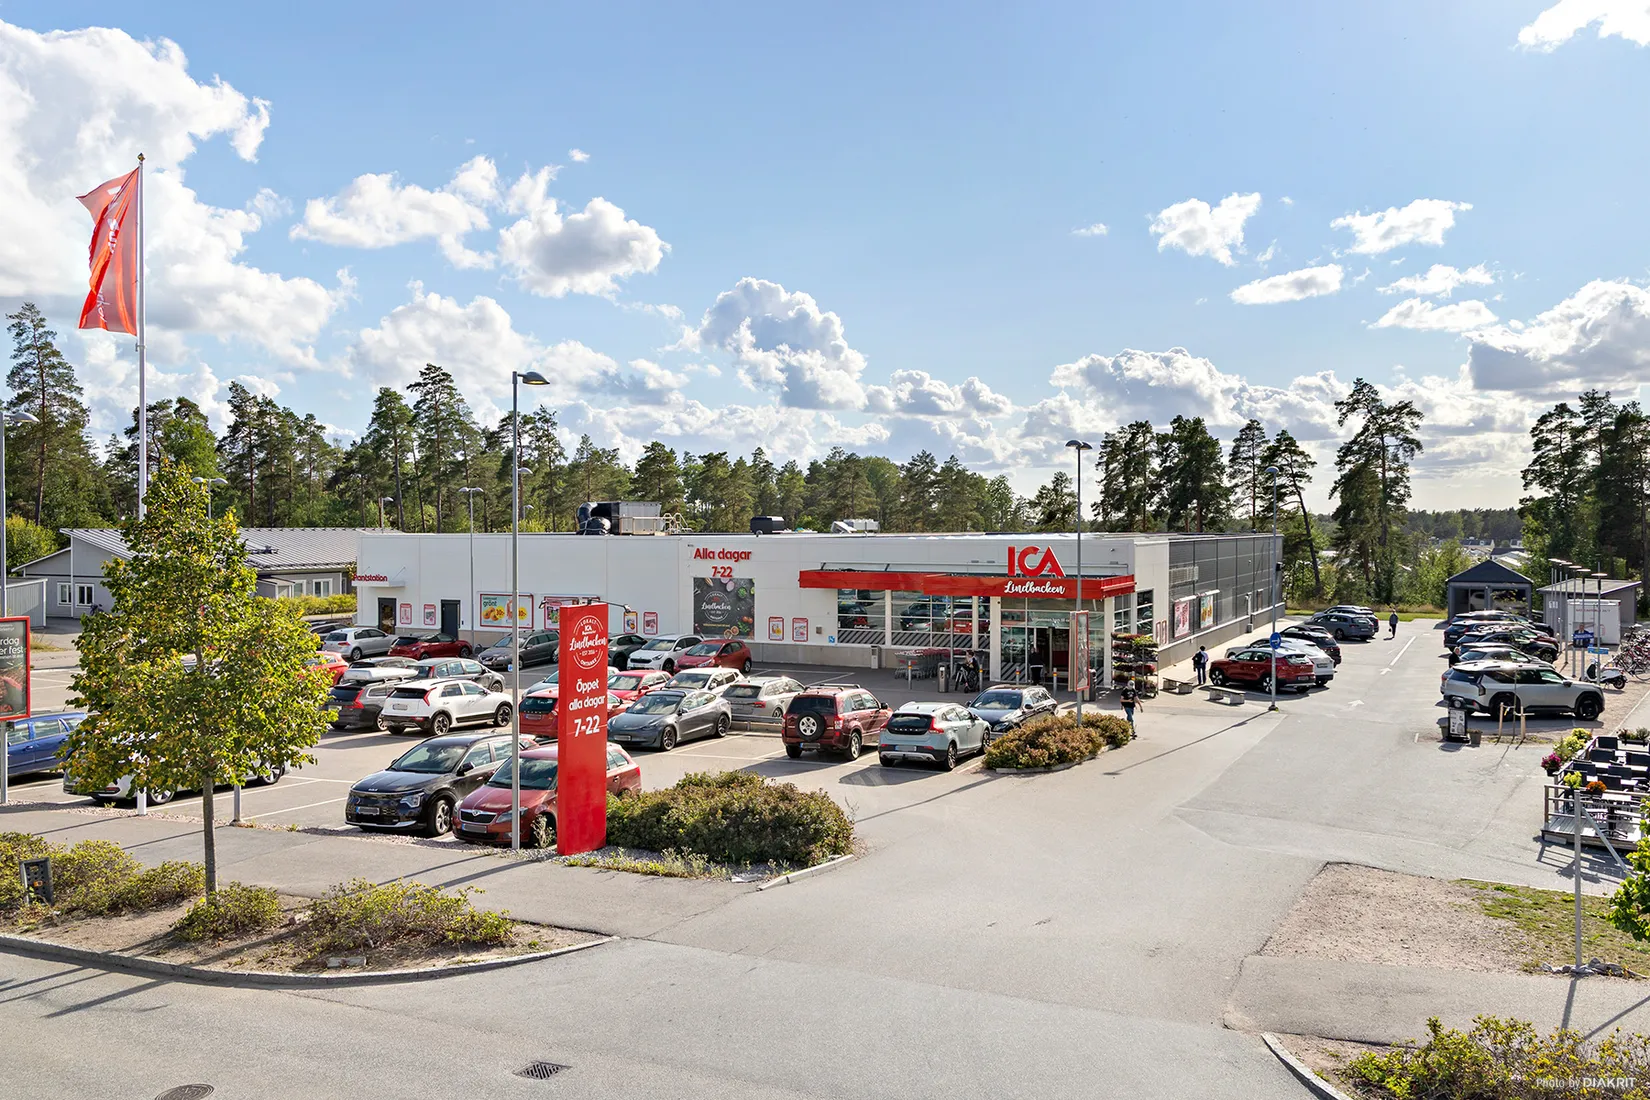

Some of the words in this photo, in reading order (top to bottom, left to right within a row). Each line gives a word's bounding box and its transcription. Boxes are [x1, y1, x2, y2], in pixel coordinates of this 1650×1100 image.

[694, 548, 715, 560] Alla
[717, 548, 752, 562] dagar
[1007, 545, 1067, 577] ICA
[353, 573, 387, 581] Pantstation
[712, 566, 732, 577] 7-22
[1004, 580, 1065, 595] Lindbacken
[8, 646, 23, 654] fest
[569, 635, 607, 650] Lindbacken
[576, 679, 599, 694] Öppet
[569, 699, 583, 711] alla
[584, 695, 605, 708] dagar
[574, 714, 600, 738] 7-22
